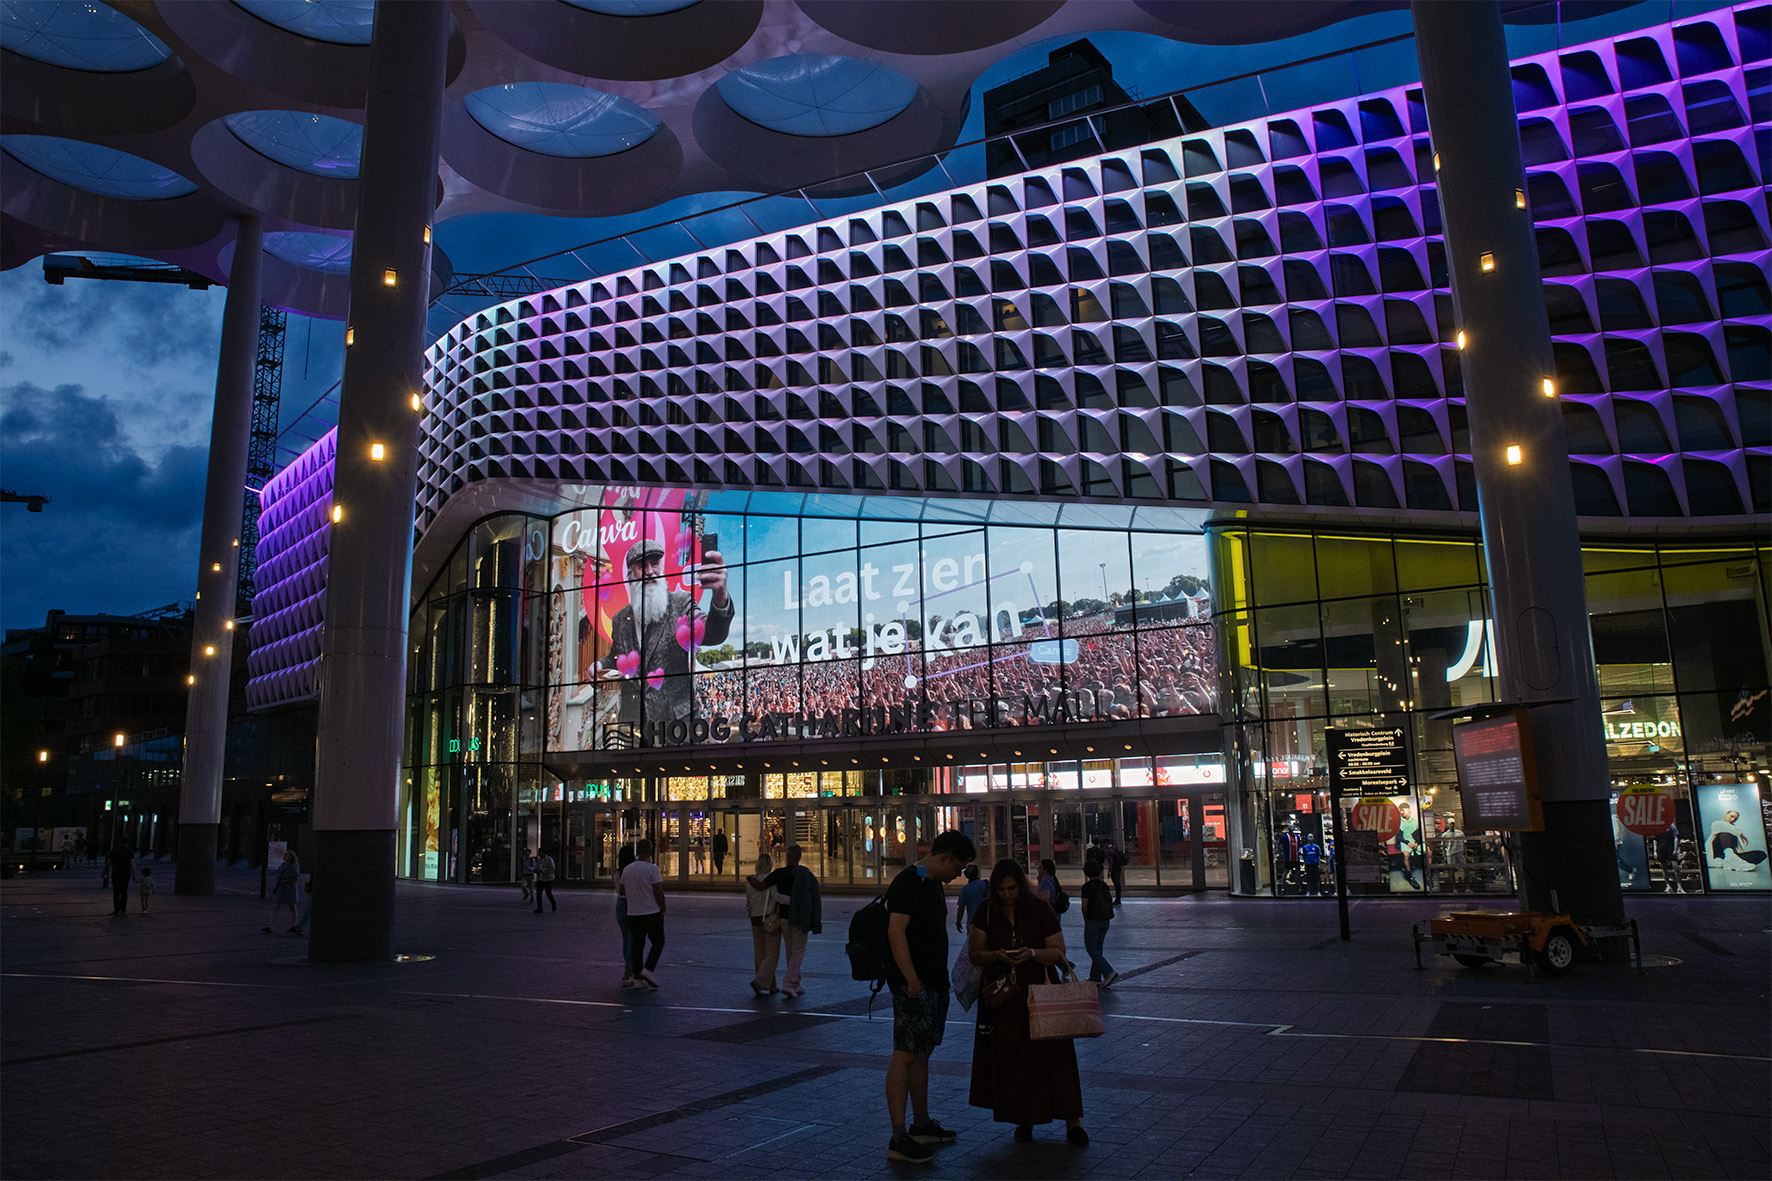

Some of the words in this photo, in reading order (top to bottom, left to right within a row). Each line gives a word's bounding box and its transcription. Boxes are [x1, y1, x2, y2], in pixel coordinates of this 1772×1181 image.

[562, 520, 638, 554] Canva
[784, 561, 886, 611] Laat
[892, 549, 991, 598] zien
[771, 621, 852, 665] wat
[863, 612, 907, 671] je
[925, 600, 1023, 663] kan
[1038, 645, 1071, 656] Cana
[649, 718, 731, 746] HOOG
[739, 702, 935, 743] CATHARIJNE
[946, 697, 1010, 730] THE
[1023, 690, 1113, 726] MALL
[1358, 805, 1394, 832] SALE
[1624, 795, 1667, 826] SALE
